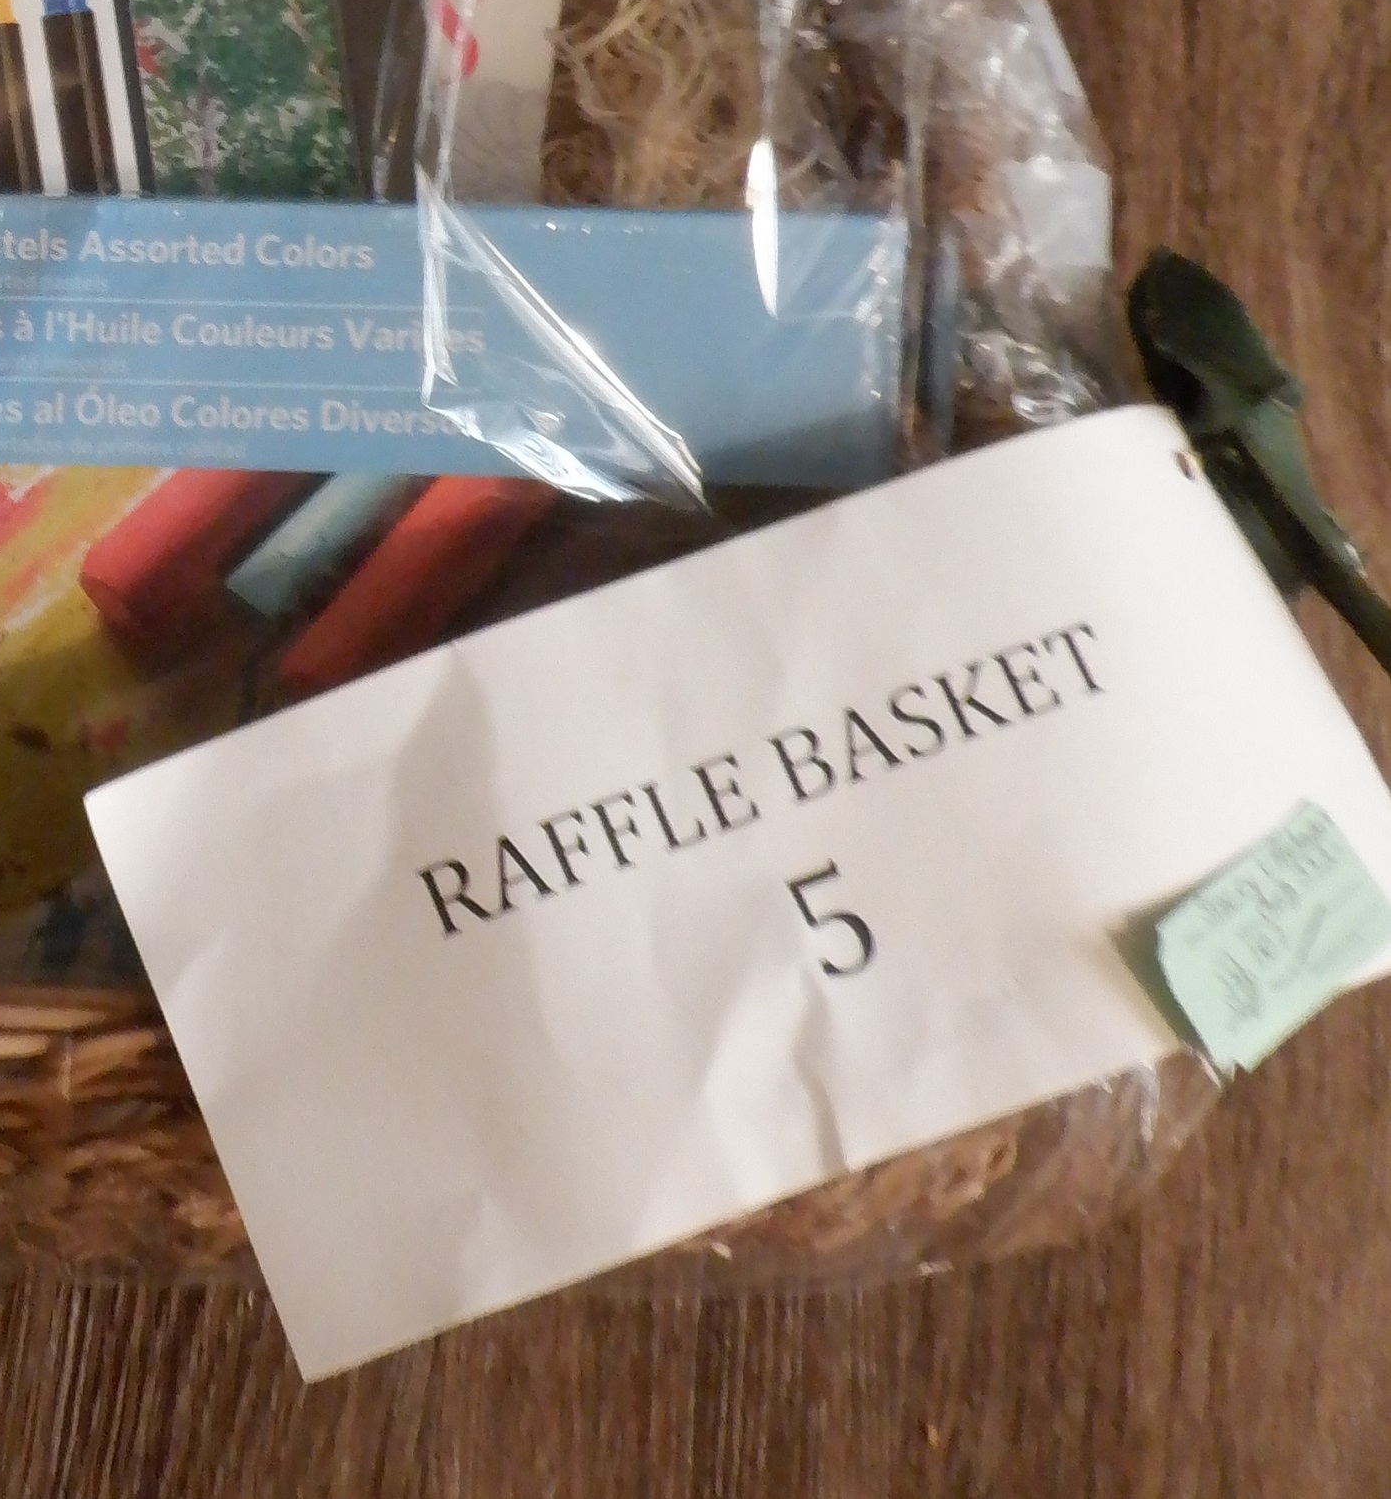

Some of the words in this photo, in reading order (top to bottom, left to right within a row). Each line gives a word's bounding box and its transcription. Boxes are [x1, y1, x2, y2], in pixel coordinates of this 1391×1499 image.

[78, 230, 246, 266] Assorted
[255, 232, 377, 270] Colors
[13, 309, 35, 342] à
[45, 309, 163, 347] l'Huile
[170, 313, 334, 349] Couleurs
[33, 391, 66, 424] al
[74, 385, 162, 427] Óleo
[170, 395, 309, 431] Colores
[417, 751, 763, 938] RAFFLE
[767, 620, 1107, 803] BASKET
[786, 858, 878, 979] 5
